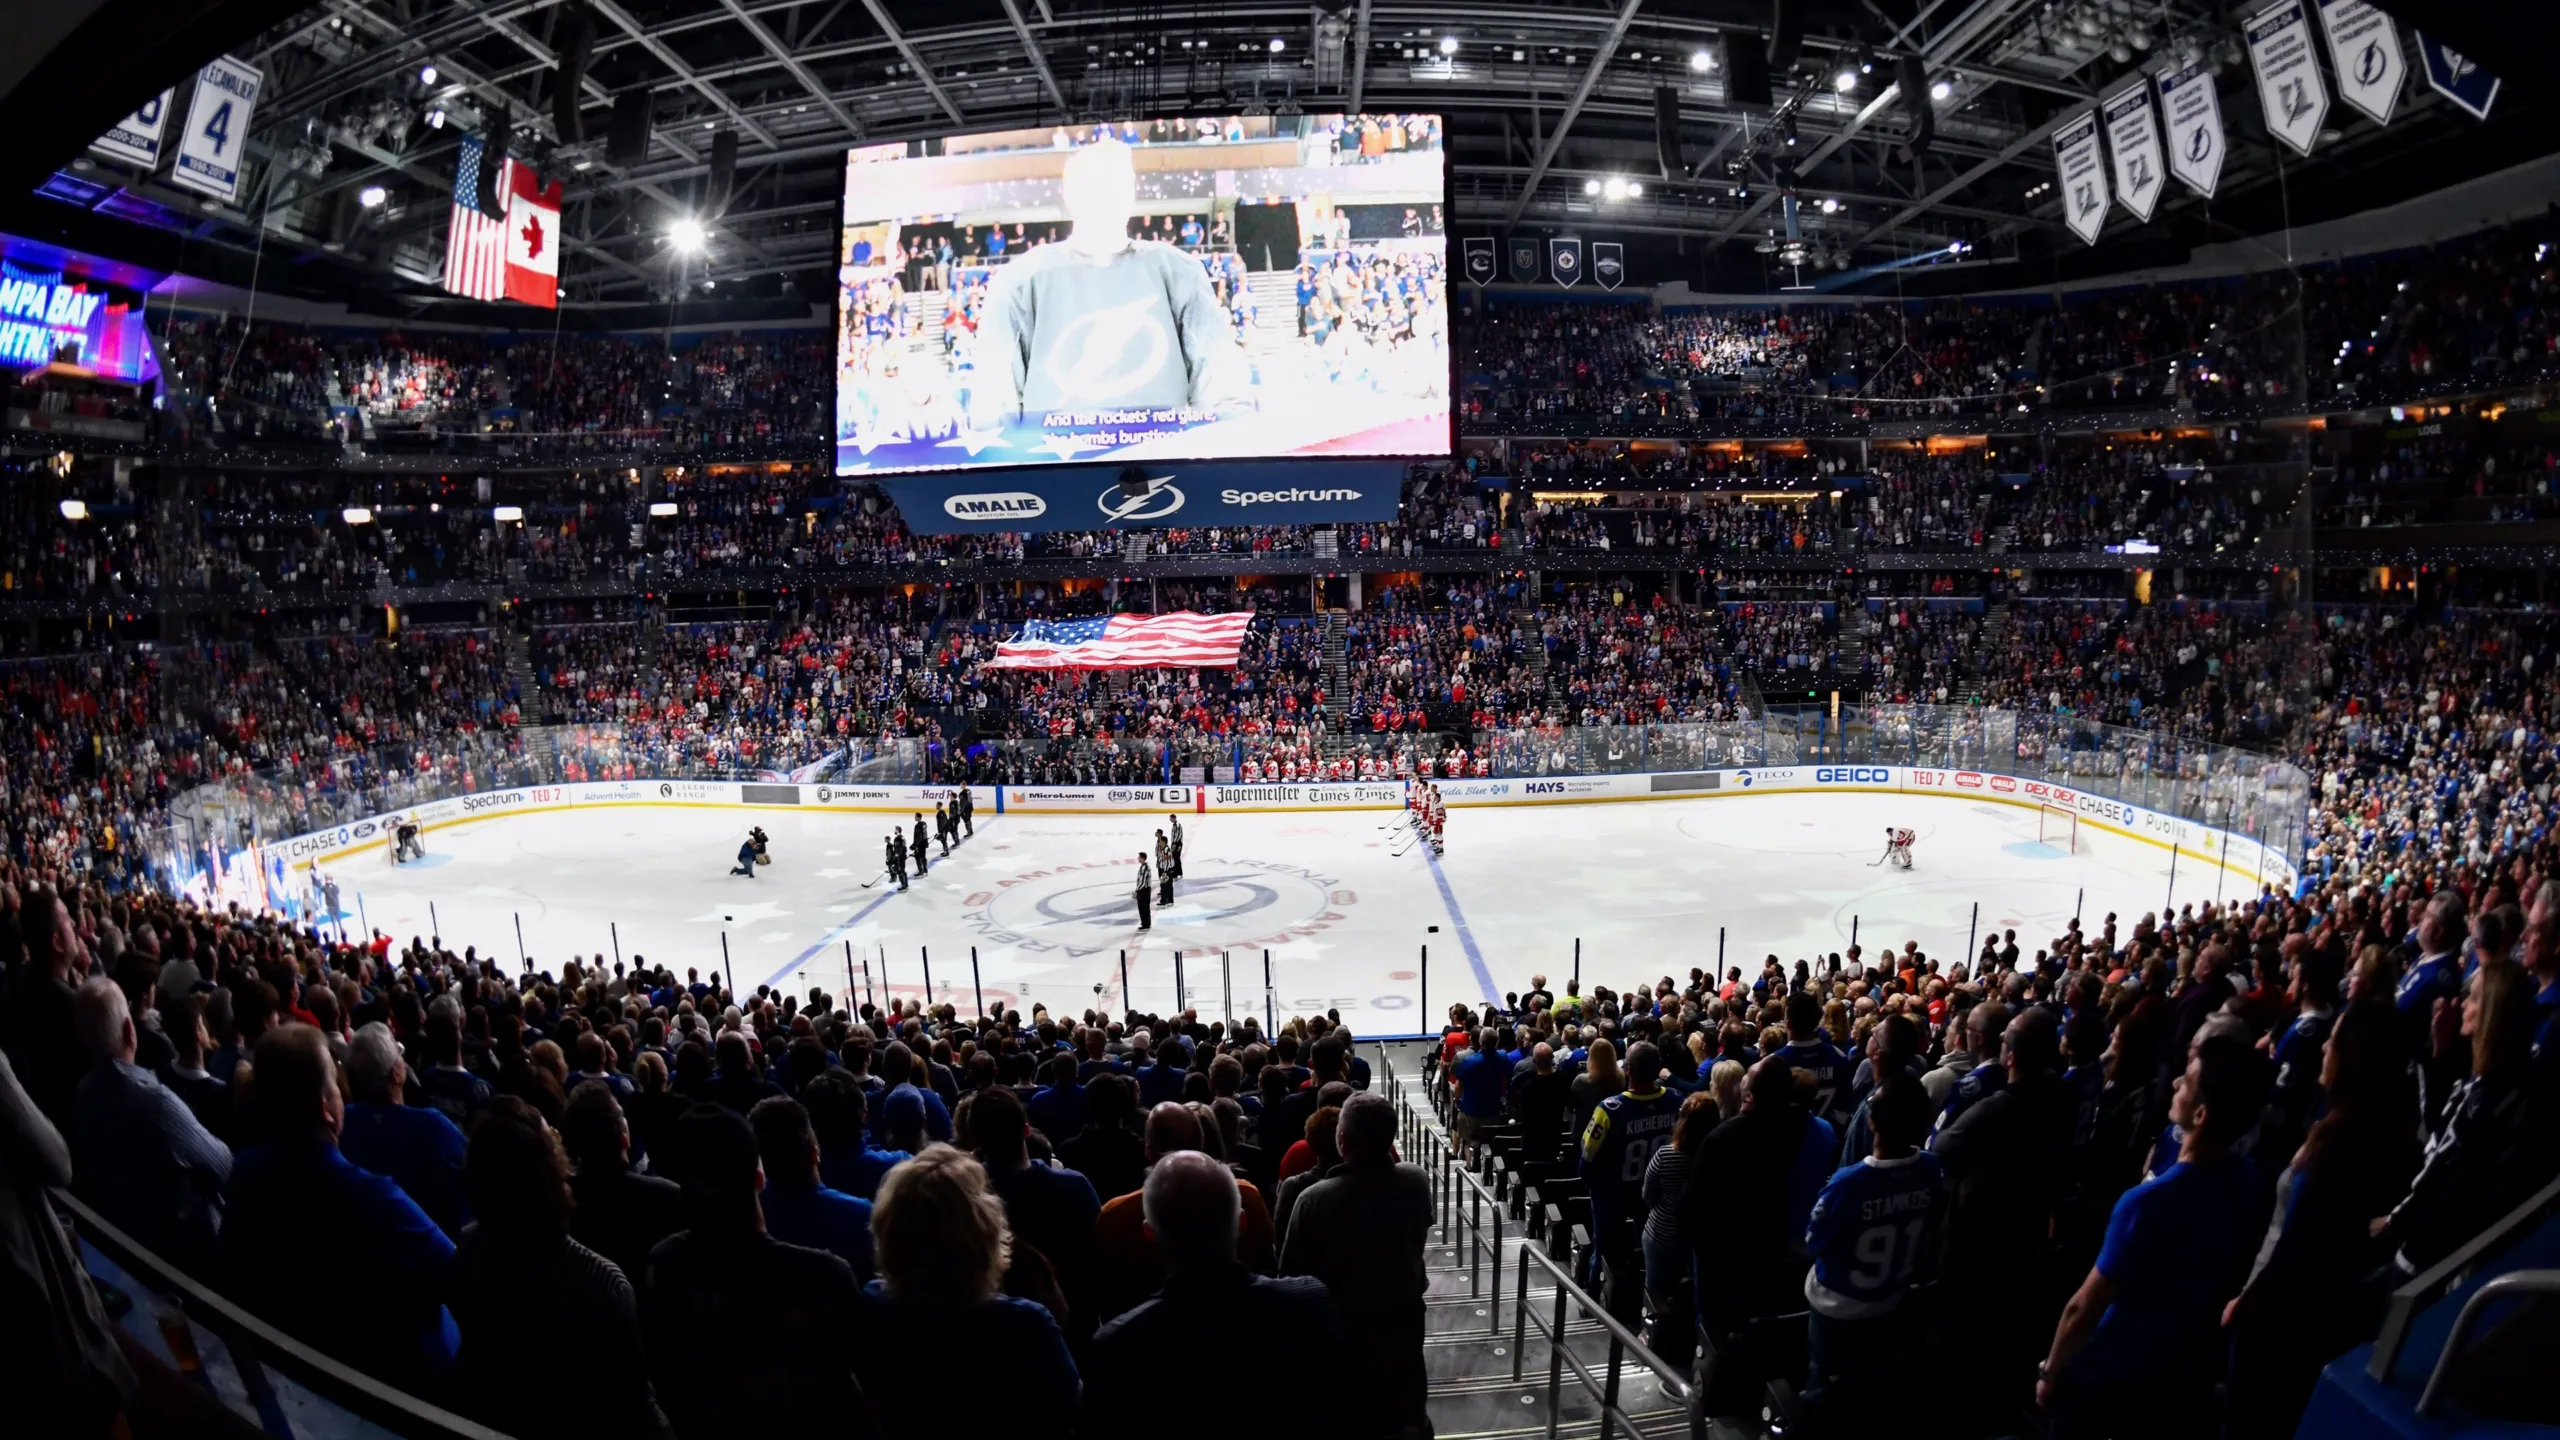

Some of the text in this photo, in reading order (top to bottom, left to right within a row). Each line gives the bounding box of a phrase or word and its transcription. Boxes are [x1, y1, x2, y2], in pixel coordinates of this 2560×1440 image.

[203, 62, 254, 100] LECAVALIER
[203, 99, 232, 156] 4
[46, 284, 99, 327] BAY
[1043, 412, 1072, 427] And
[1100, 409, 1150, 425] rockets'
[1153, 406, 1176, 422] red
[1222, 488, 1353, 507] Spectrum
[955, 499, 1039, 513] AMALIE
[1755, 771, 1794, 779] TECO
[1816, 768, 1889, 783] GEICO
[1913, 771, 1932, 785] TED
[532, 790, 550, 802] TED
[834, 791, 890, 799] JIMMY JOHN'S
[921, 789, 945, 800] Hard
[1134, 791, 1154, 800] SUN
[1308, 788, 1350, 802] Times
[1465, 786, 1487, 796] Blue
[1525, 782, 1565, 794] HAYS
[2024, 782, 2049, 797] DEX
[2053, 788, 2076, 804] DEX
[463, 792, 520, 812] Spectrum
[2079, 796, 2120, 821] CHASE
[2146, 813, 2187, 839] Publix
[292, 832, 336, 857] CHASE
[1198, 857, 1341, 888] ARENA
[1861, 1187, 1932, 1222] STAMKOS
[1848, 1216, 1928, 1291] 91
